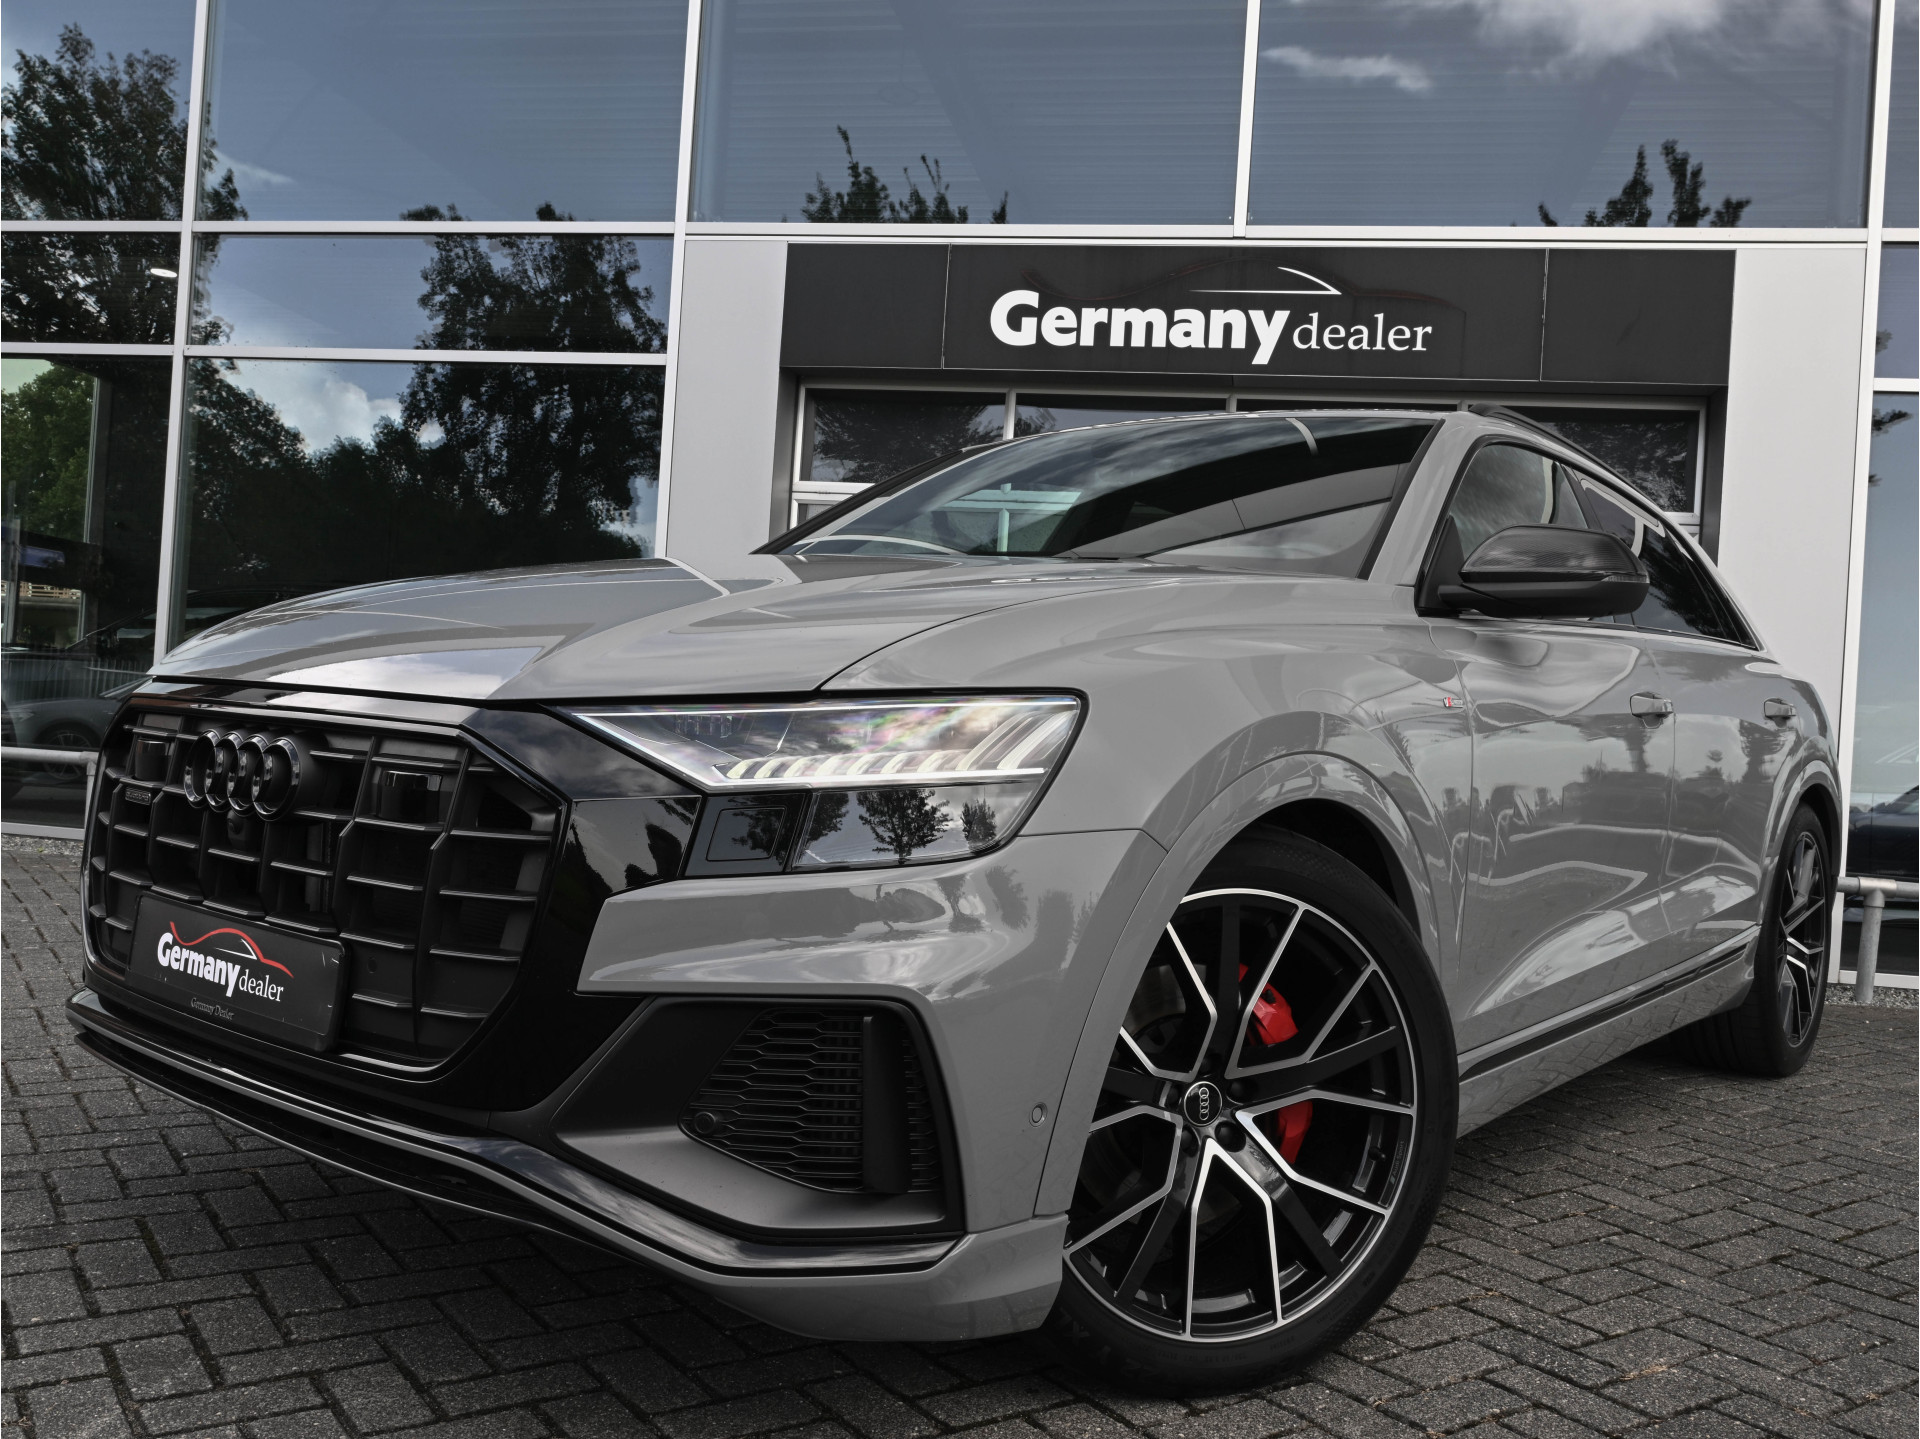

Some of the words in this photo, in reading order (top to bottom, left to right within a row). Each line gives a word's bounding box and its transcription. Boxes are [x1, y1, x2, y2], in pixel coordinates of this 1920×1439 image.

[990, 289, 1291, 365] Germany
[1292, 313, 1433, 351] dealer
[157, 932, 241, 998] Germany
[238, 969, 284, 1002] dealer
